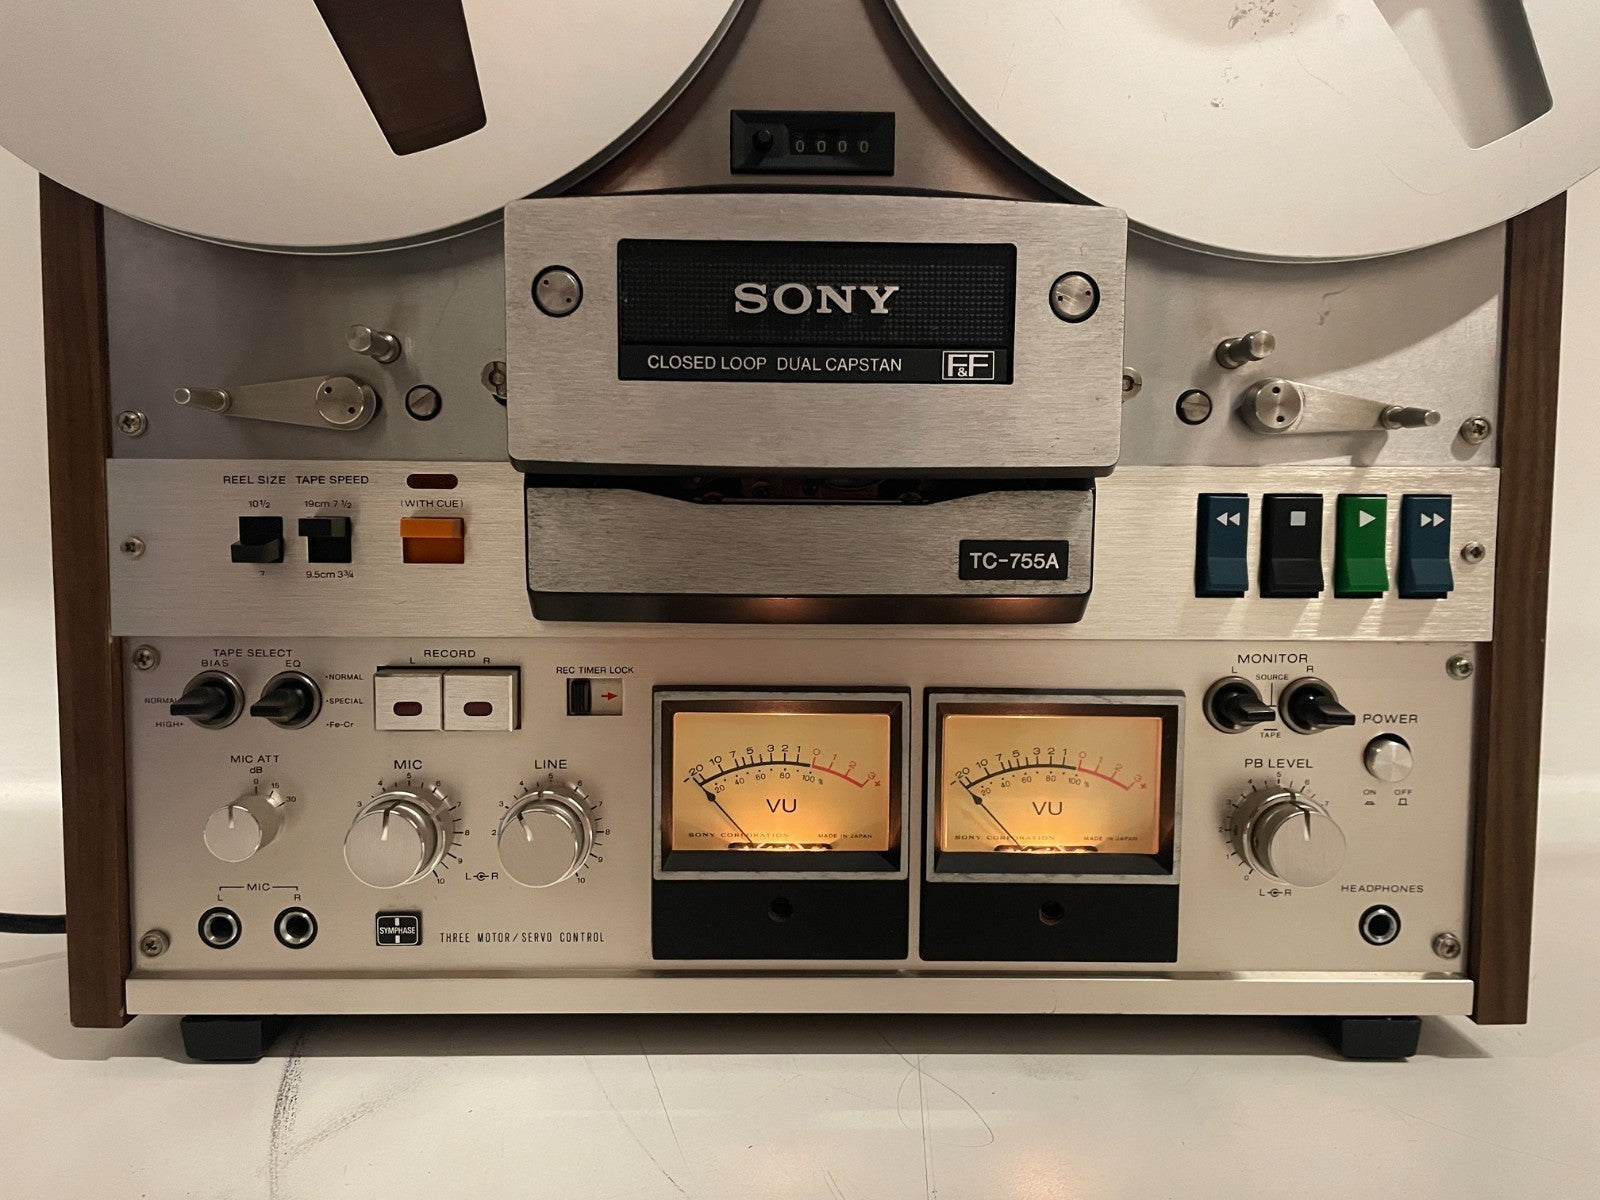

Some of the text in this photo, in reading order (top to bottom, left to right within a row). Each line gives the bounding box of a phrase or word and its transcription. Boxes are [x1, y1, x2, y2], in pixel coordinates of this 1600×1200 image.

[734, 282, 900, 315] SONY
[647, 355, 902, 372] CLOSED LOOP DUAL CAPSTAN
[223, 476, 286, 485] REEL SIZE
[296, 476, 369, 485] TAPE SPEED
[304, 500, 330, 508] 19cm
[969, 552, 1059, 570] TC-755A
[306, 570, 336, 579] 9.5cm
[213, 649, 293, 657] TAPE SELECT
[423, 649, 476, 658] RECORD
[1237, 653, 1308, 664] MONITOR
[285, 660, 301, 668] EQ
[556, 666, 634, 674] REC TIMER LOCK
[1231, 666, 1238, 674] L
[1306, 665, 1314, 673] R
[1362, 714, 1418, 724] POWER
[230, 755, 280, 763] MIC ATT
[709, 755, 722, 766] 10
[729, 750, 736, 758] 7
[746, 746, 754, 755] 5
[766, 744, 775, 752] 3
[848, 760, 856, 769] 2
[975, 758, 989, 769] 10
[995, 753, 1002, 761] 7
[1012, 749, 1020, 758] 5
[1032, 747, 1041, 755] 3
[1047, 747, 1056, 755] 2
[1078, 751, 1087, 759] 0
[1114, 763, 1123, 772] 2
[394, 760, 422, 770] MIC
[534, 760, 567, 770] LINE
[1244, 758, 1313, 768] PB LEVEL
[249, 766, 262, 774] dB
[714, 784, 726, 794] 20
[734, 777, 745, 786] 40
[755, 773, 766, 781] 60
[802, 774, 816, 783] 100
[980, 787, 992, 796] 20
[1000, 780, 1011, 788] 40
[1021, 776, 1032, 784] 60
[1068, 777, 1082, 786] 100
[766, 798, 796, 813] VU
[1032, 801, 1063, 816] VU
[246, 883, 270, 891] MIC
[1341, 884, 1424, 893] HEADPHONES
[379, 926, 415, 934] SYMPHASE
[440, 932, 470, 942] THREE
[560, 932, 604, 942] CONTROL
